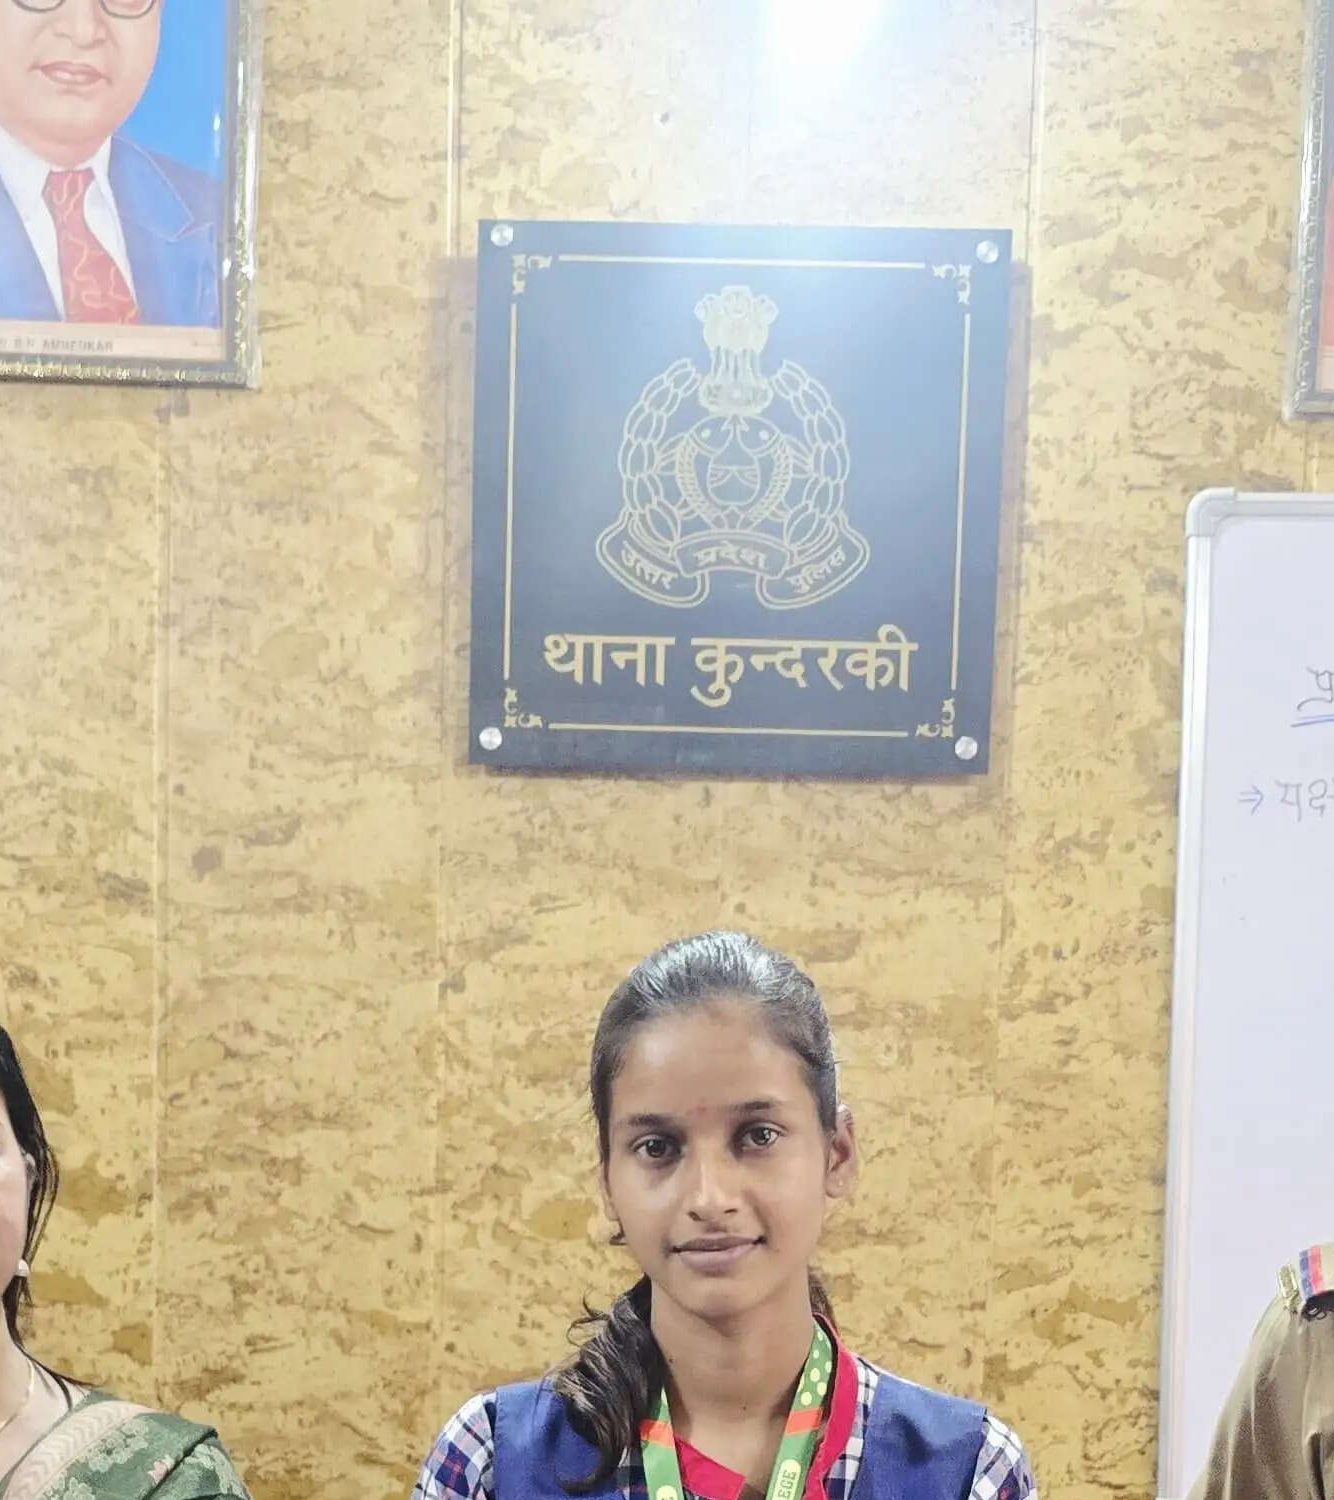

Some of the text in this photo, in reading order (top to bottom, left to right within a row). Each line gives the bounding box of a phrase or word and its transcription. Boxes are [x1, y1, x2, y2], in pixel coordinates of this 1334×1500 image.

[692, 540, 768, 569] प्रदेश
[785, 545, 847, 593] पुलिस
[542, 624, 919, 707] थाना कुन्दरकी
